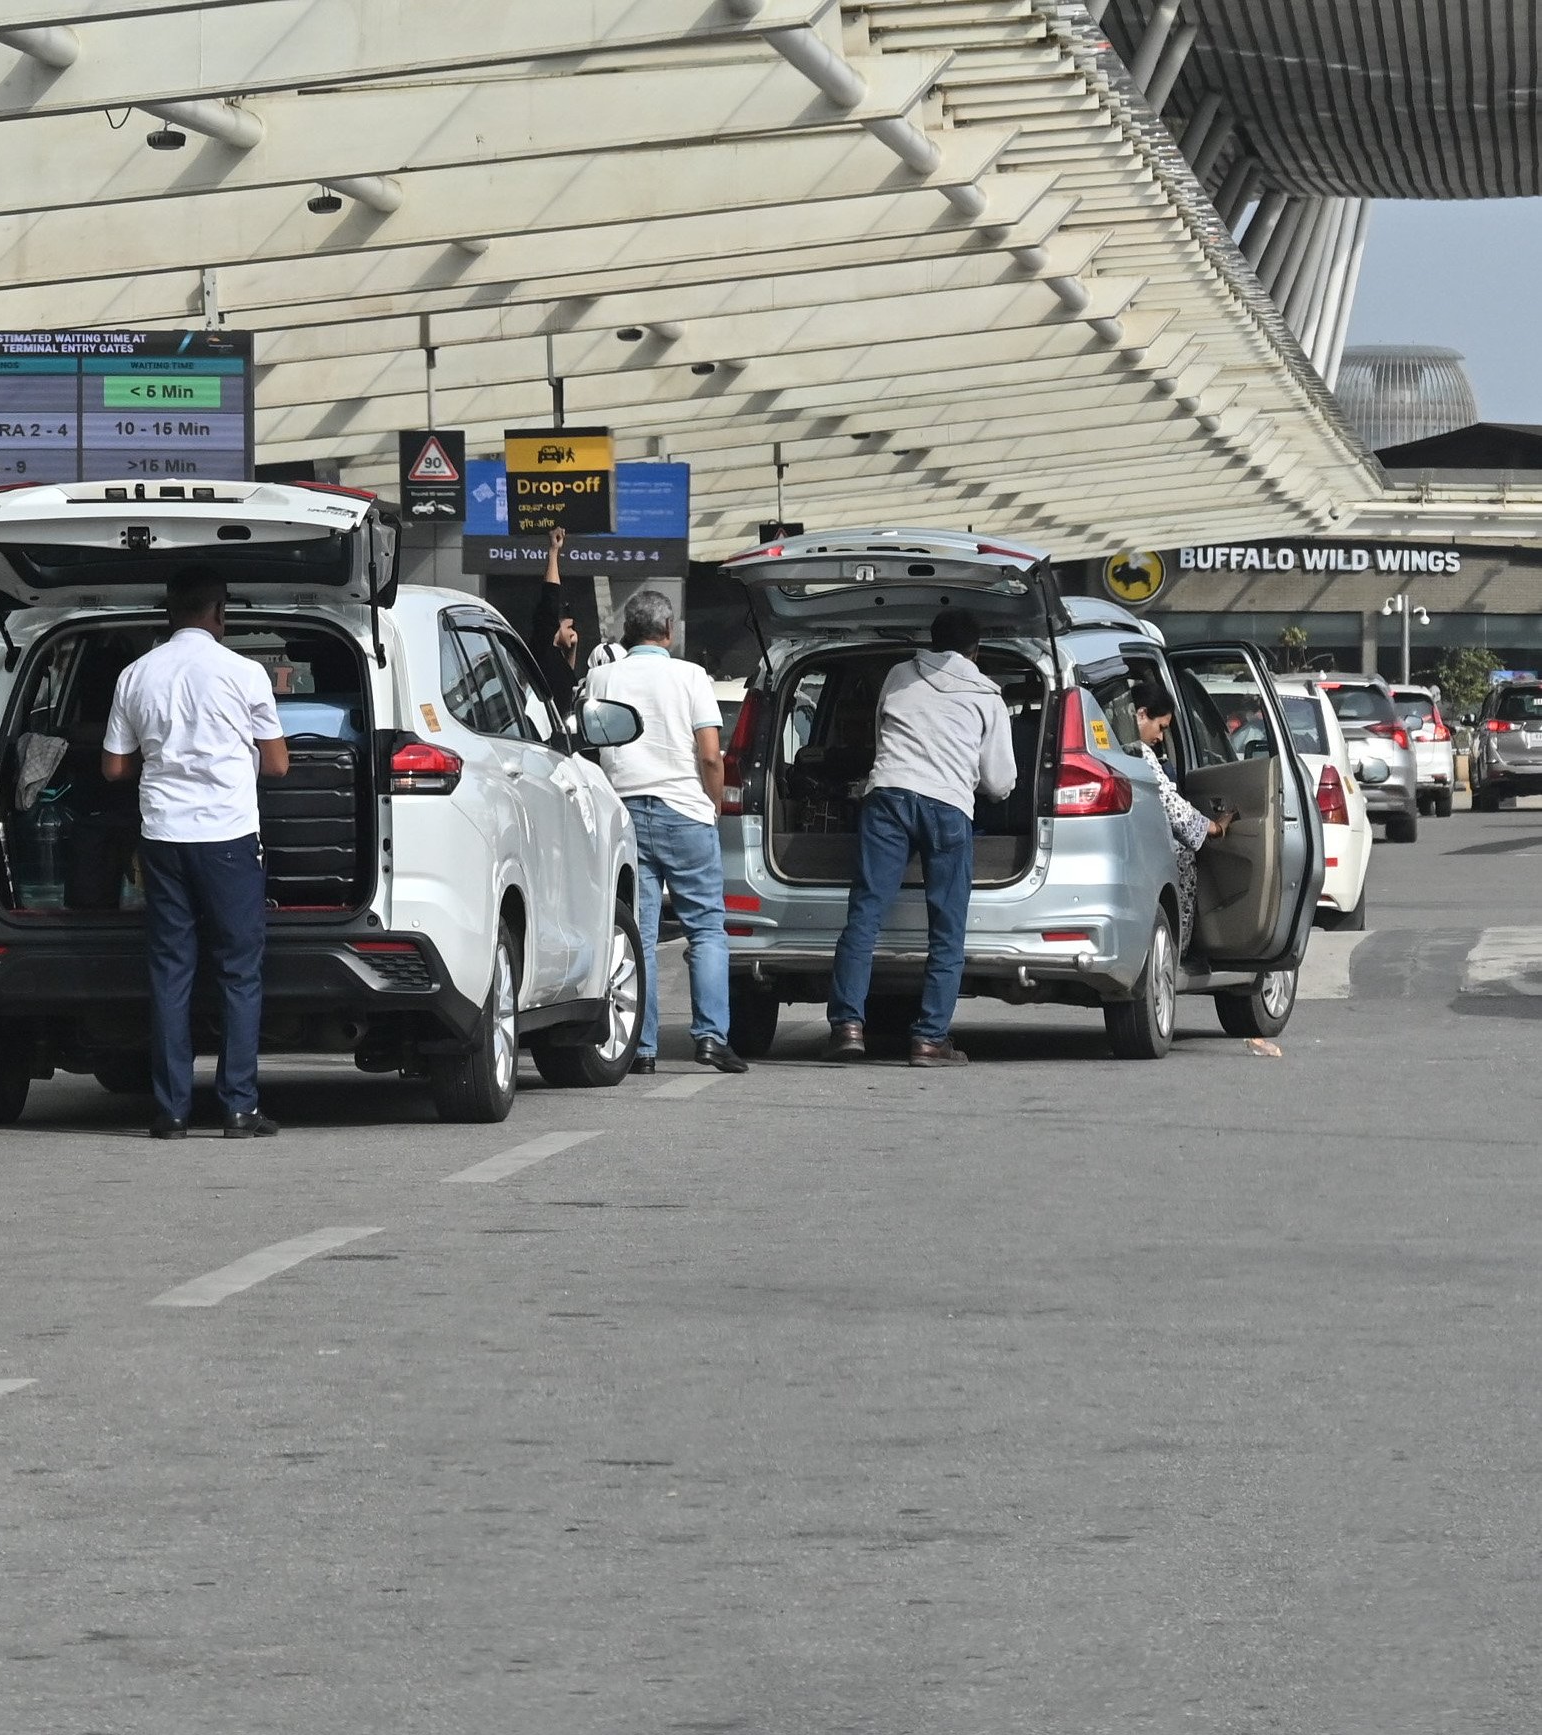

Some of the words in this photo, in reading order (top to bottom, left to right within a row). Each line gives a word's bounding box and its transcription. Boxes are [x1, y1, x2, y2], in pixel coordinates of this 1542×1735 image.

[55, 334, 101, 343] WAITING
[103, 334, 130, 343] TIME
[132, 334, 146, 343] AT
[2, 344, 58, 353] TERMINAL
[61, 344, 95, 353] ENTRY
[99, 344, 134, 353] GATES
[130, 361, 170, 370] WAITING
[172, 361, 194, 370] TIME
[130, 386, 140, 397] <
[162, 385, 194, 398] Min
[31, 423, 40, 437] 2
[58, 423, 67, 437] 4
[115, 422, 134, 435] 10
[153, 422, 172, 435] 15
[178, 422, 210, 436] Min
[16, 460, 27, 474] 9
[165, 459, 197, 473] Min
[424, 456, 442, 469] 90
[517, 476, 601, 496] Drop-off
[489, 548, 517, 561] Digi
[521, 548, 548, 560] Yatr
[569, 550, 602, 561] Gate
[622, 550, 632, 561] 3
[649, 550, 660, 561] 4
[1179, 547, 1295, 570] BUFFALO
[1302, 549, 1369, 571] WILD
[1376, 550, 1461, 573] WINGS
